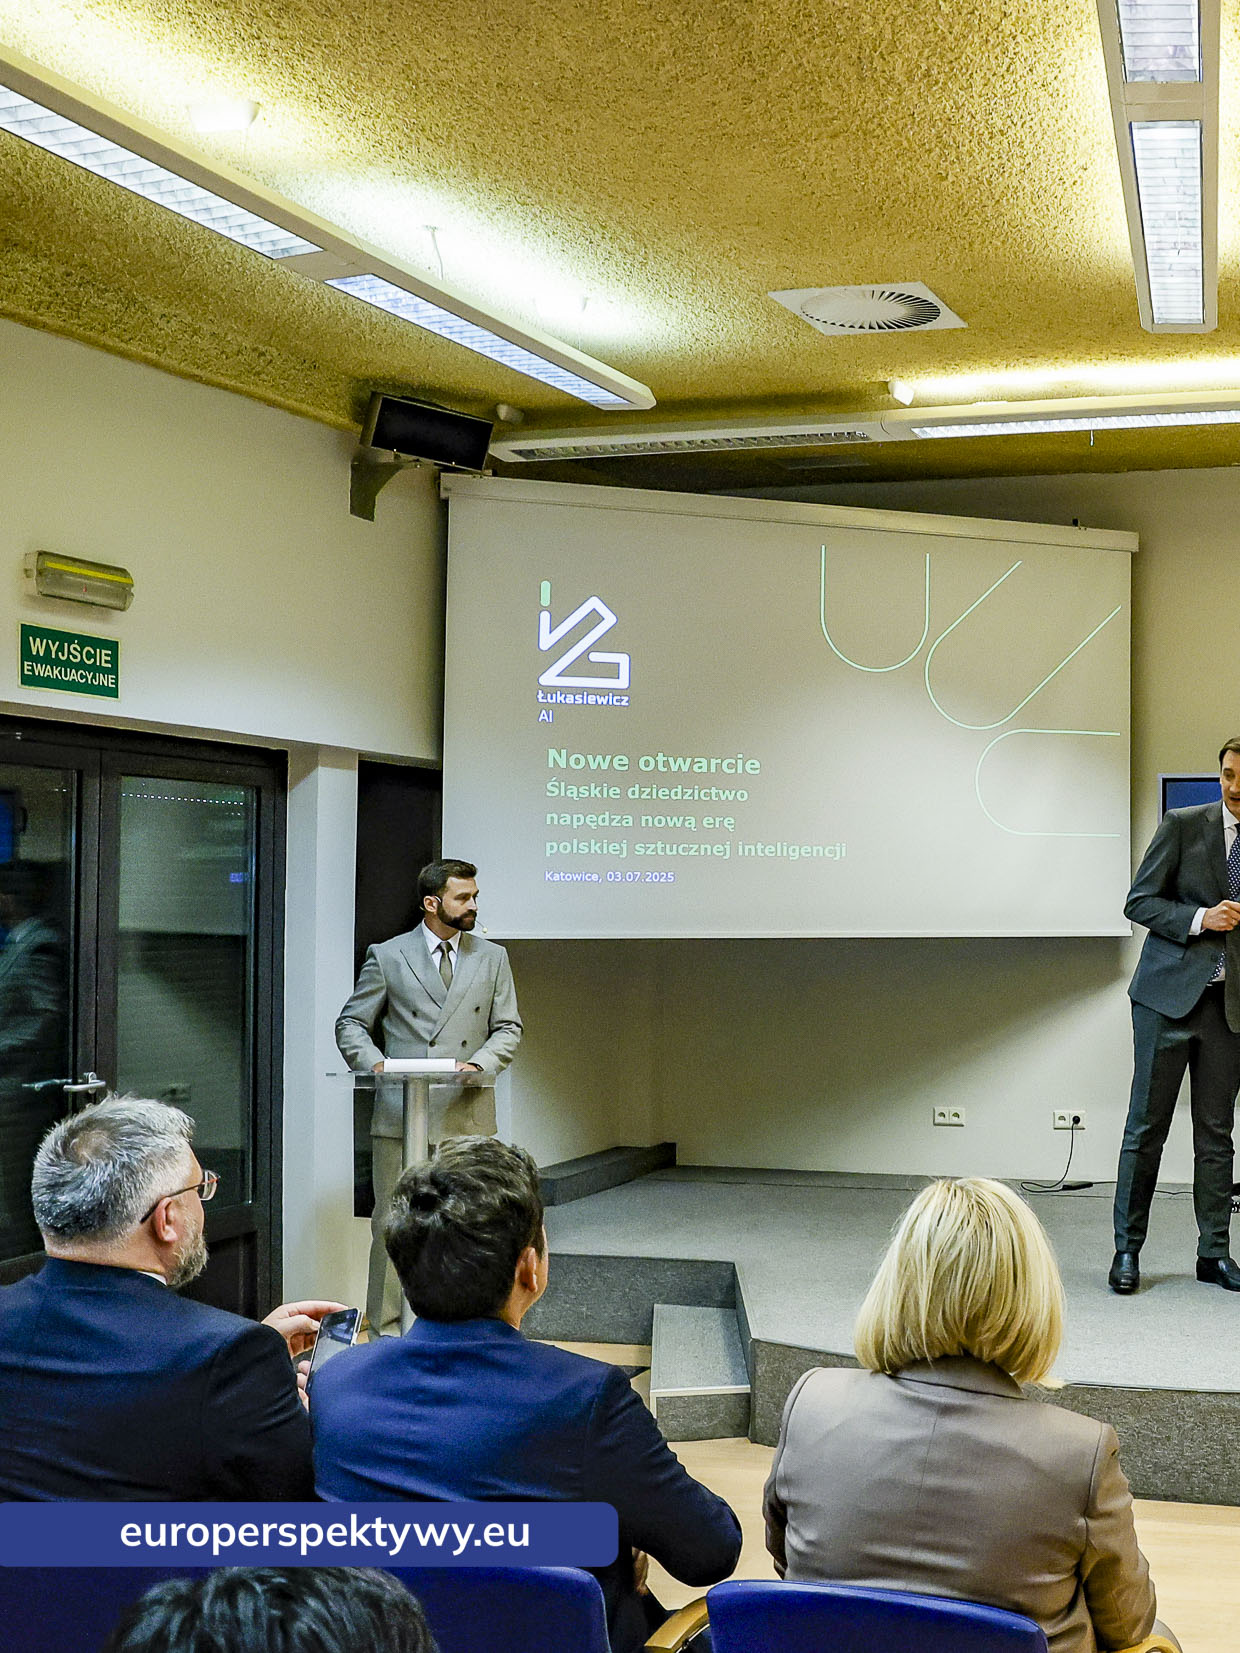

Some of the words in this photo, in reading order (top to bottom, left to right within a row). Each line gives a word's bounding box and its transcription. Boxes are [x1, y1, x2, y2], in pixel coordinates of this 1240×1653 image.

[29, 636, 112, 668] WYJŚCIE
[24, 660, 116, 688] EWAKUACYJNE
[537, 690, 629, 706] Łukasiewicz
[538, 709, 553, 723] AI
[547, 748, 629, 772] Nowe
[638, 752, 761, 775] otwarcie
[546, 777, 621, 800] Śląskie
[627, 783, 749, 802] dziedzictwo
[546, 811, 633, 829] napędza
[641, 815, 697, 831] nową
[702, 818, 735, 832] erę
[545, 839, 628, 857] polskiej
[634, 841, 731, 858] sztucznej
[738, 841, 847, 860] inteligencji
[545, 871, 603, 883] Katowice,
[606, 871, 675, 883] 03.07.2025
